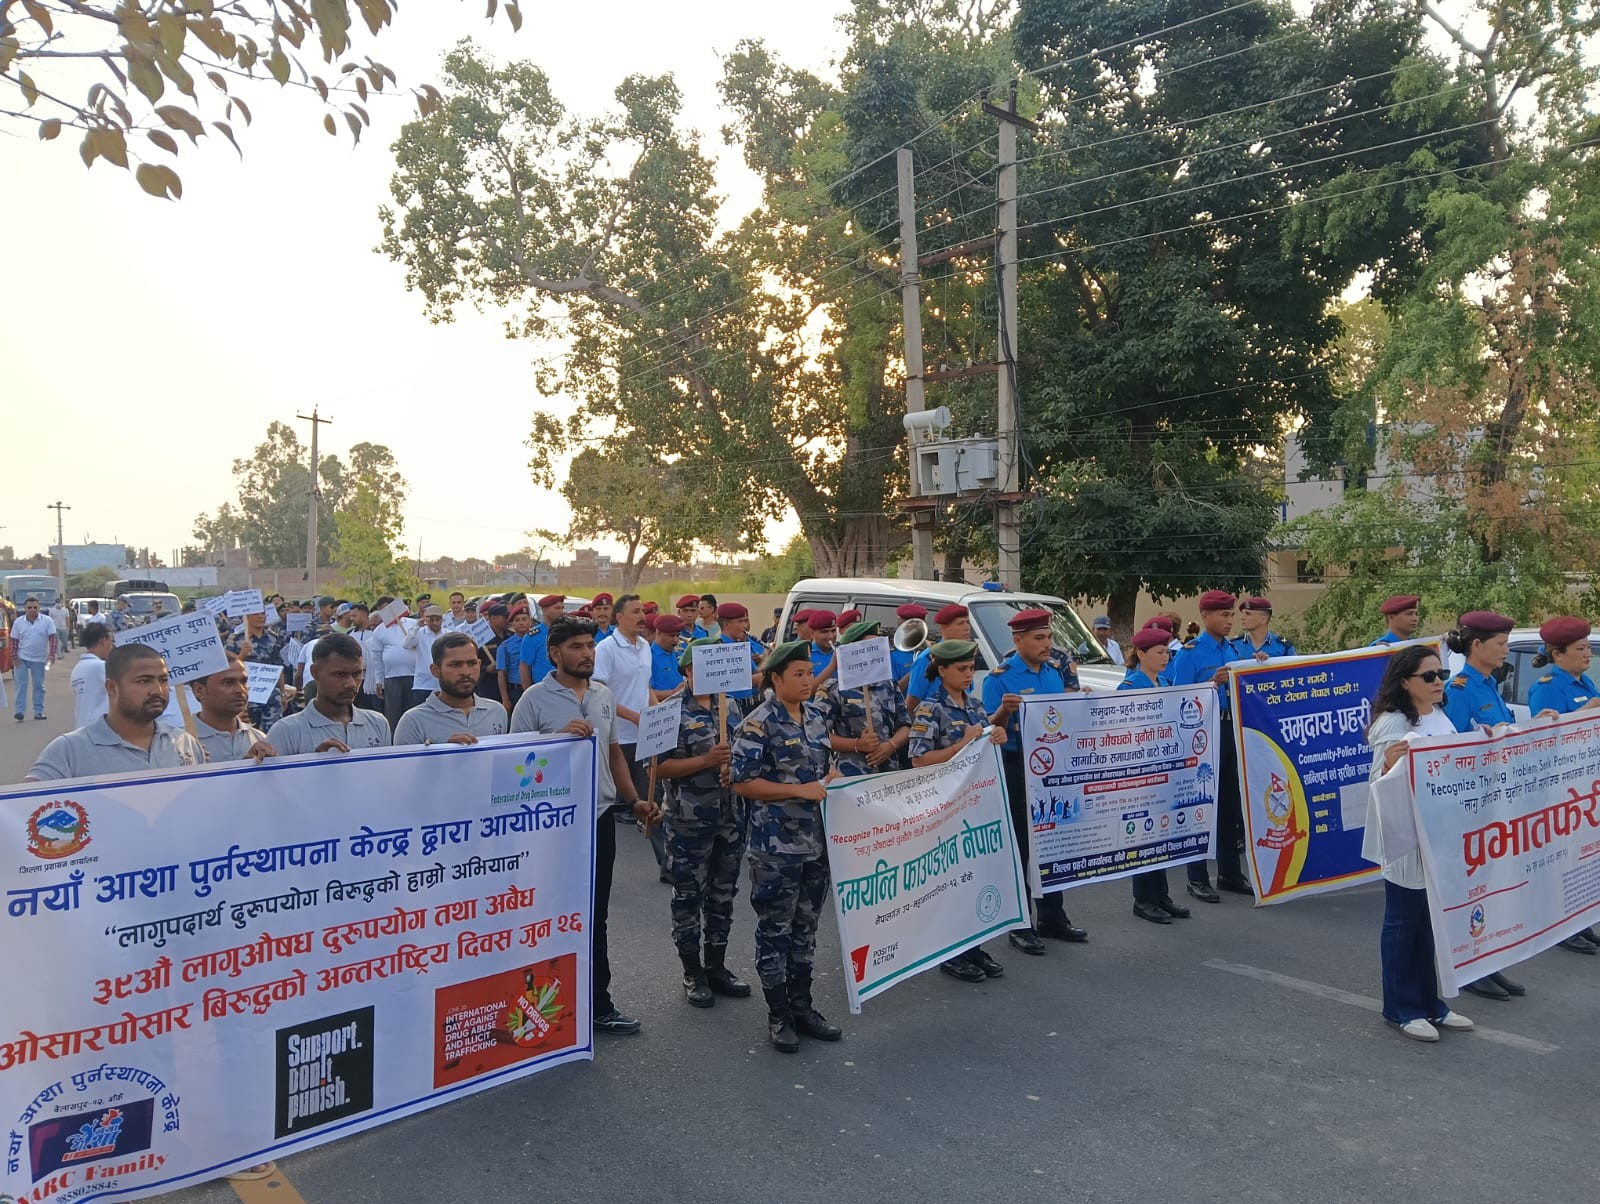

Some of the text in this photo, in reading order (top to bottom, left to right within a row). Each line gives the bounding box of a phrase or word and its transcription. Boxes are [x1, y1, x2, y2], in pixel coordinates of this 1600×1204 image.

[1076, 737, 1097, 752] लागु
[1298, 747, 1357, 765] Community-Police
[1578, 748, 1587, 760] for
[1071, 751, 1108, 768] सामाजिक
[872, 825, 884, 836] The
[885, 821, 900, 835] Drug
[961, 818, 1003, 859] नेपाल
[7, 801, 577, 917] नयाँ आशा पुर्नस्थापना केन्द्र द्वारा आयोजित
[407, 863, 446, 892] हाम्रो
[182, 931, 313, 984] लागुऔषध
[434, 899, 478, 927] तथा
[485, 885, 535, 916] अबैध
[317, 942, 450, 991] अन्तराष्ट्रिय
[457, 927, 514, 960] दिवस
[519, 918, 552, 948] जुन
[557, 912, 582, 933] २६
[873, 942, 899, 958] POSITIVE
[873, 954, 895, 967] ACTION
[445, 1000, 508, 1024] INTERNATIONAL
[445, 1011, 498, 1034] DAY AGAINST
[517, 995, 550, 1032] NO DRUGS
[445, 1021, 497, 1042] DRUG ABUSE
[445, 1032, 490, 1052] AND ILLICIT
[288, 1020, 362, 1068] Support.
[445, 1038, 497, 1061] TRAFFICKING
[19, 1082, 65, 1125] आशा
[85, 1153, 170, 1182] Family
